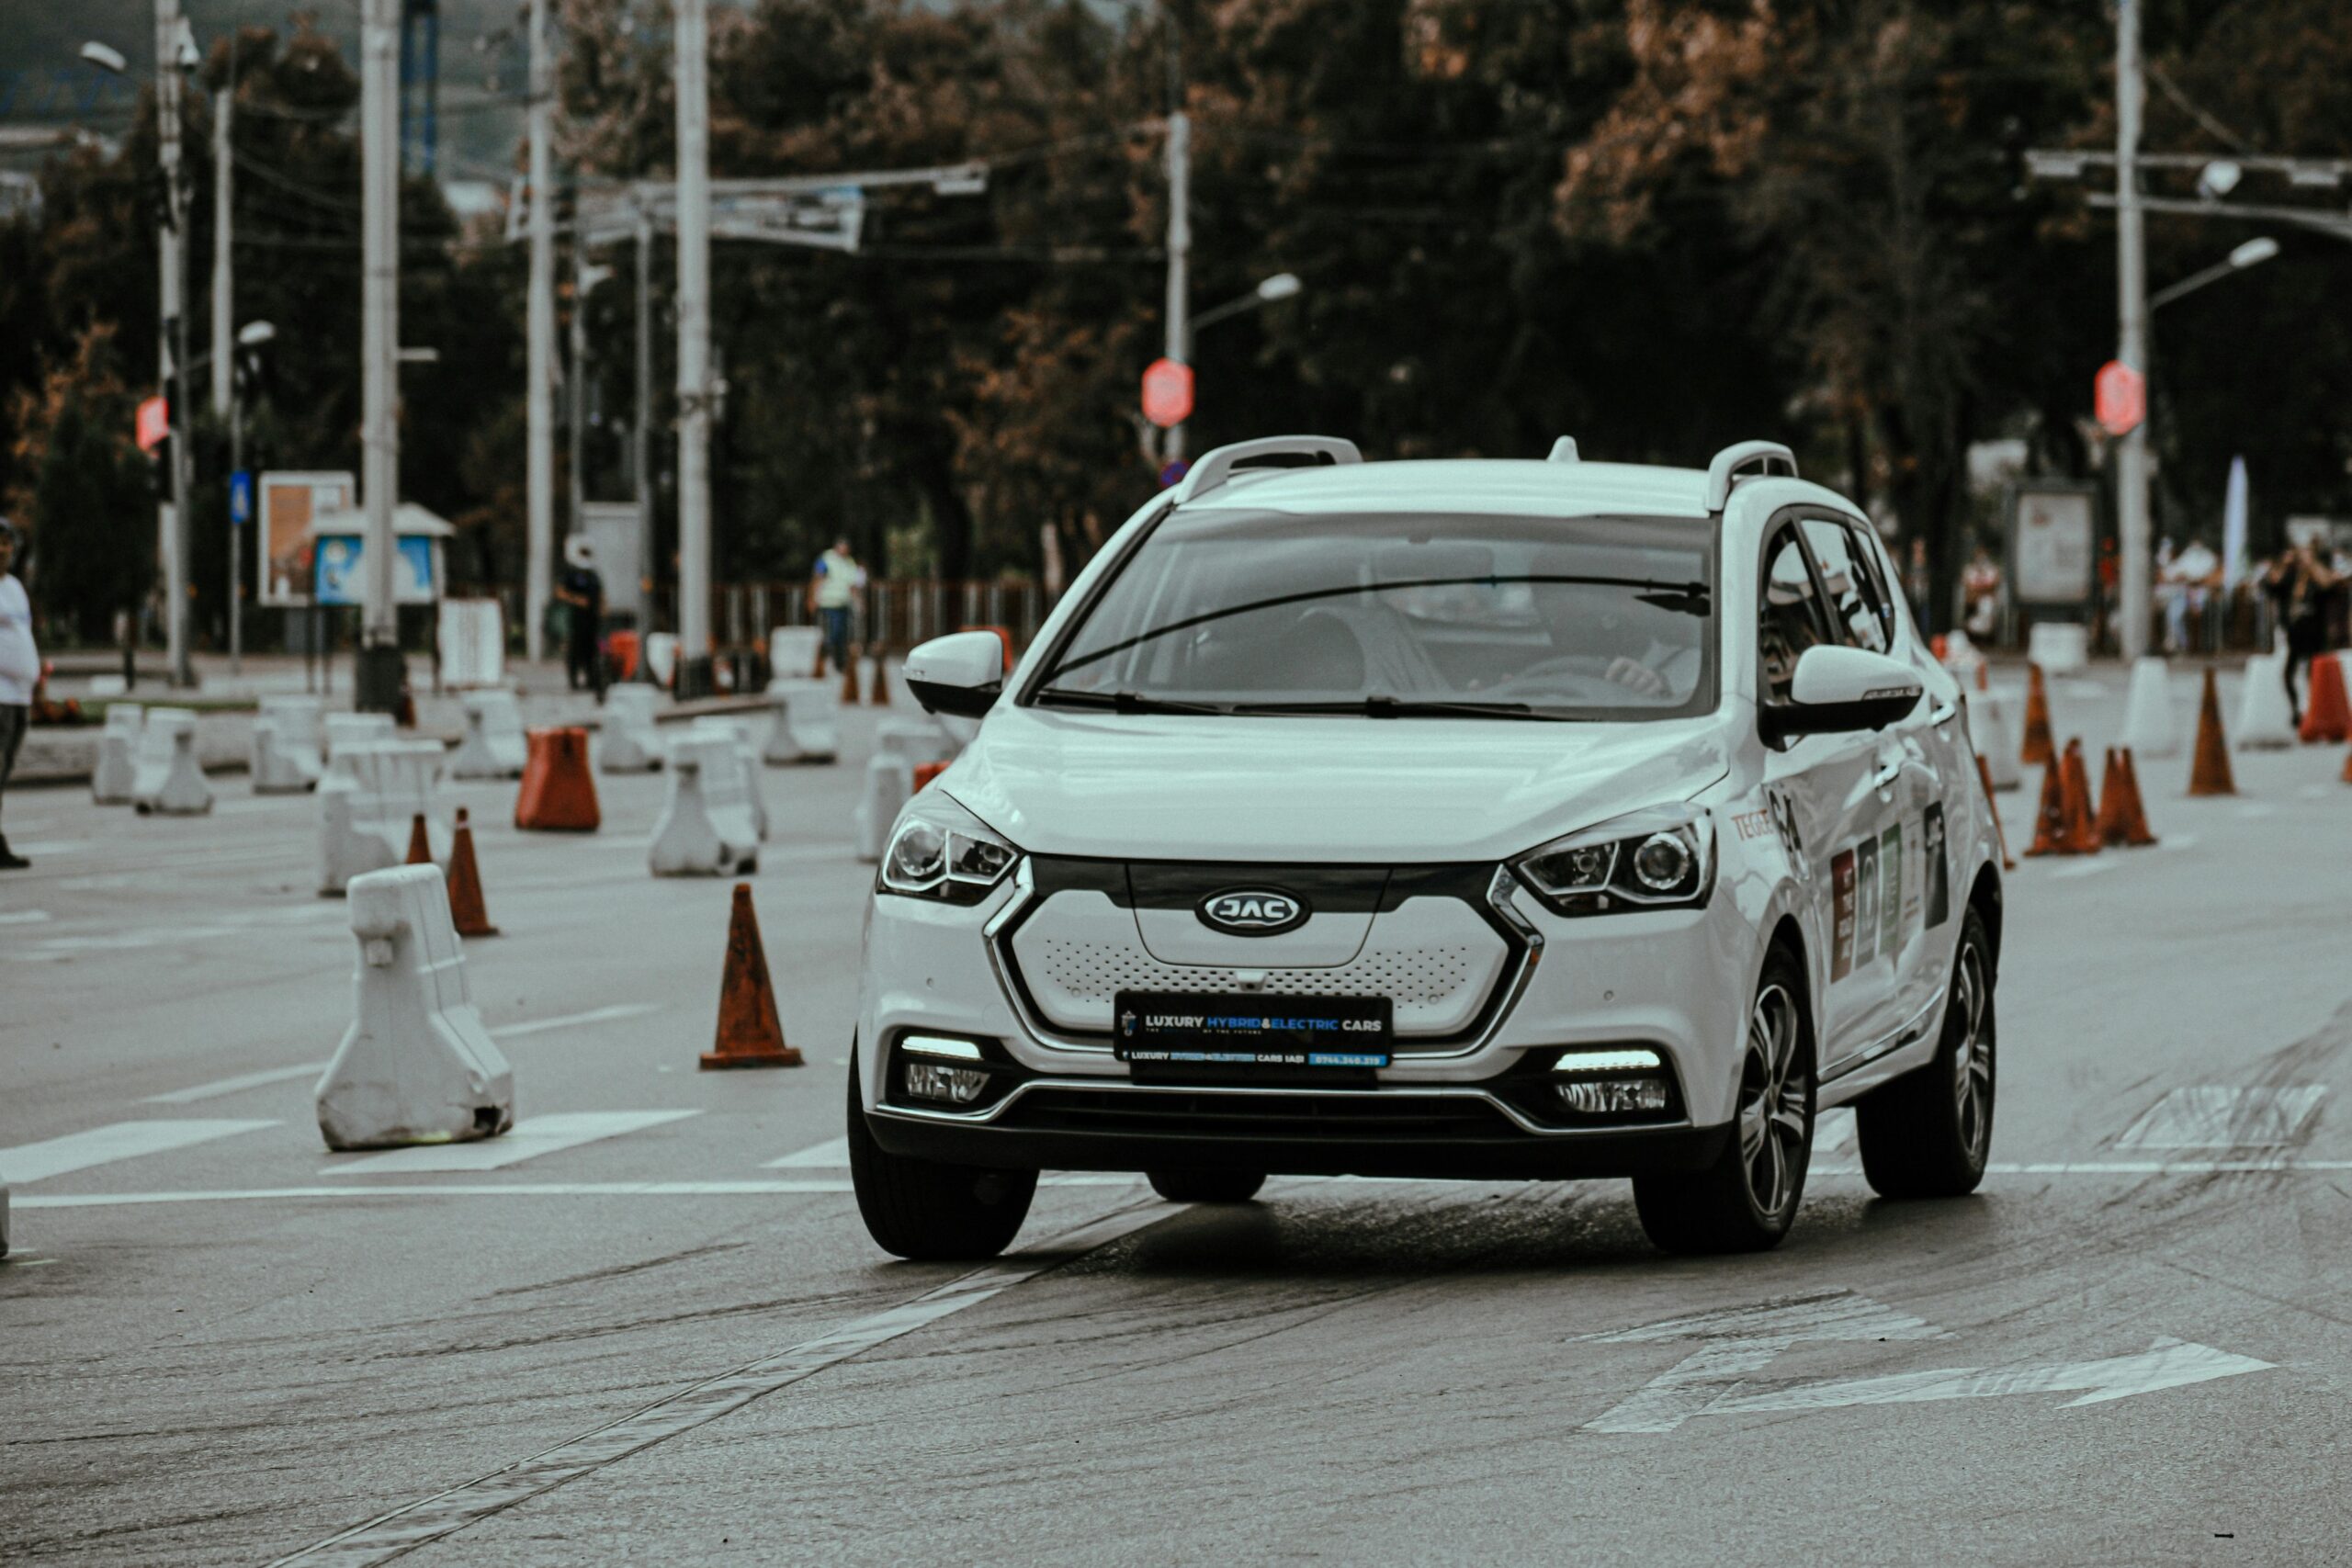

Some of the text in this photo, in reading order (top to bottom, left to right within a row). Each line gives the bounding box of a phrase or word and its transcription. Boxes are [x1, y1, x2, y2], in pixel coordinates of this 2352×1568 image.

[1219, 899, 1285, 918] JAC
[1146, 1015, 1382, 1032] LUXURY HYBRID&ELECTRIC CARS
[1131, 1051, 1169, 1060] LUXURY
[1257, 1055, 1283, 1063] CARS
